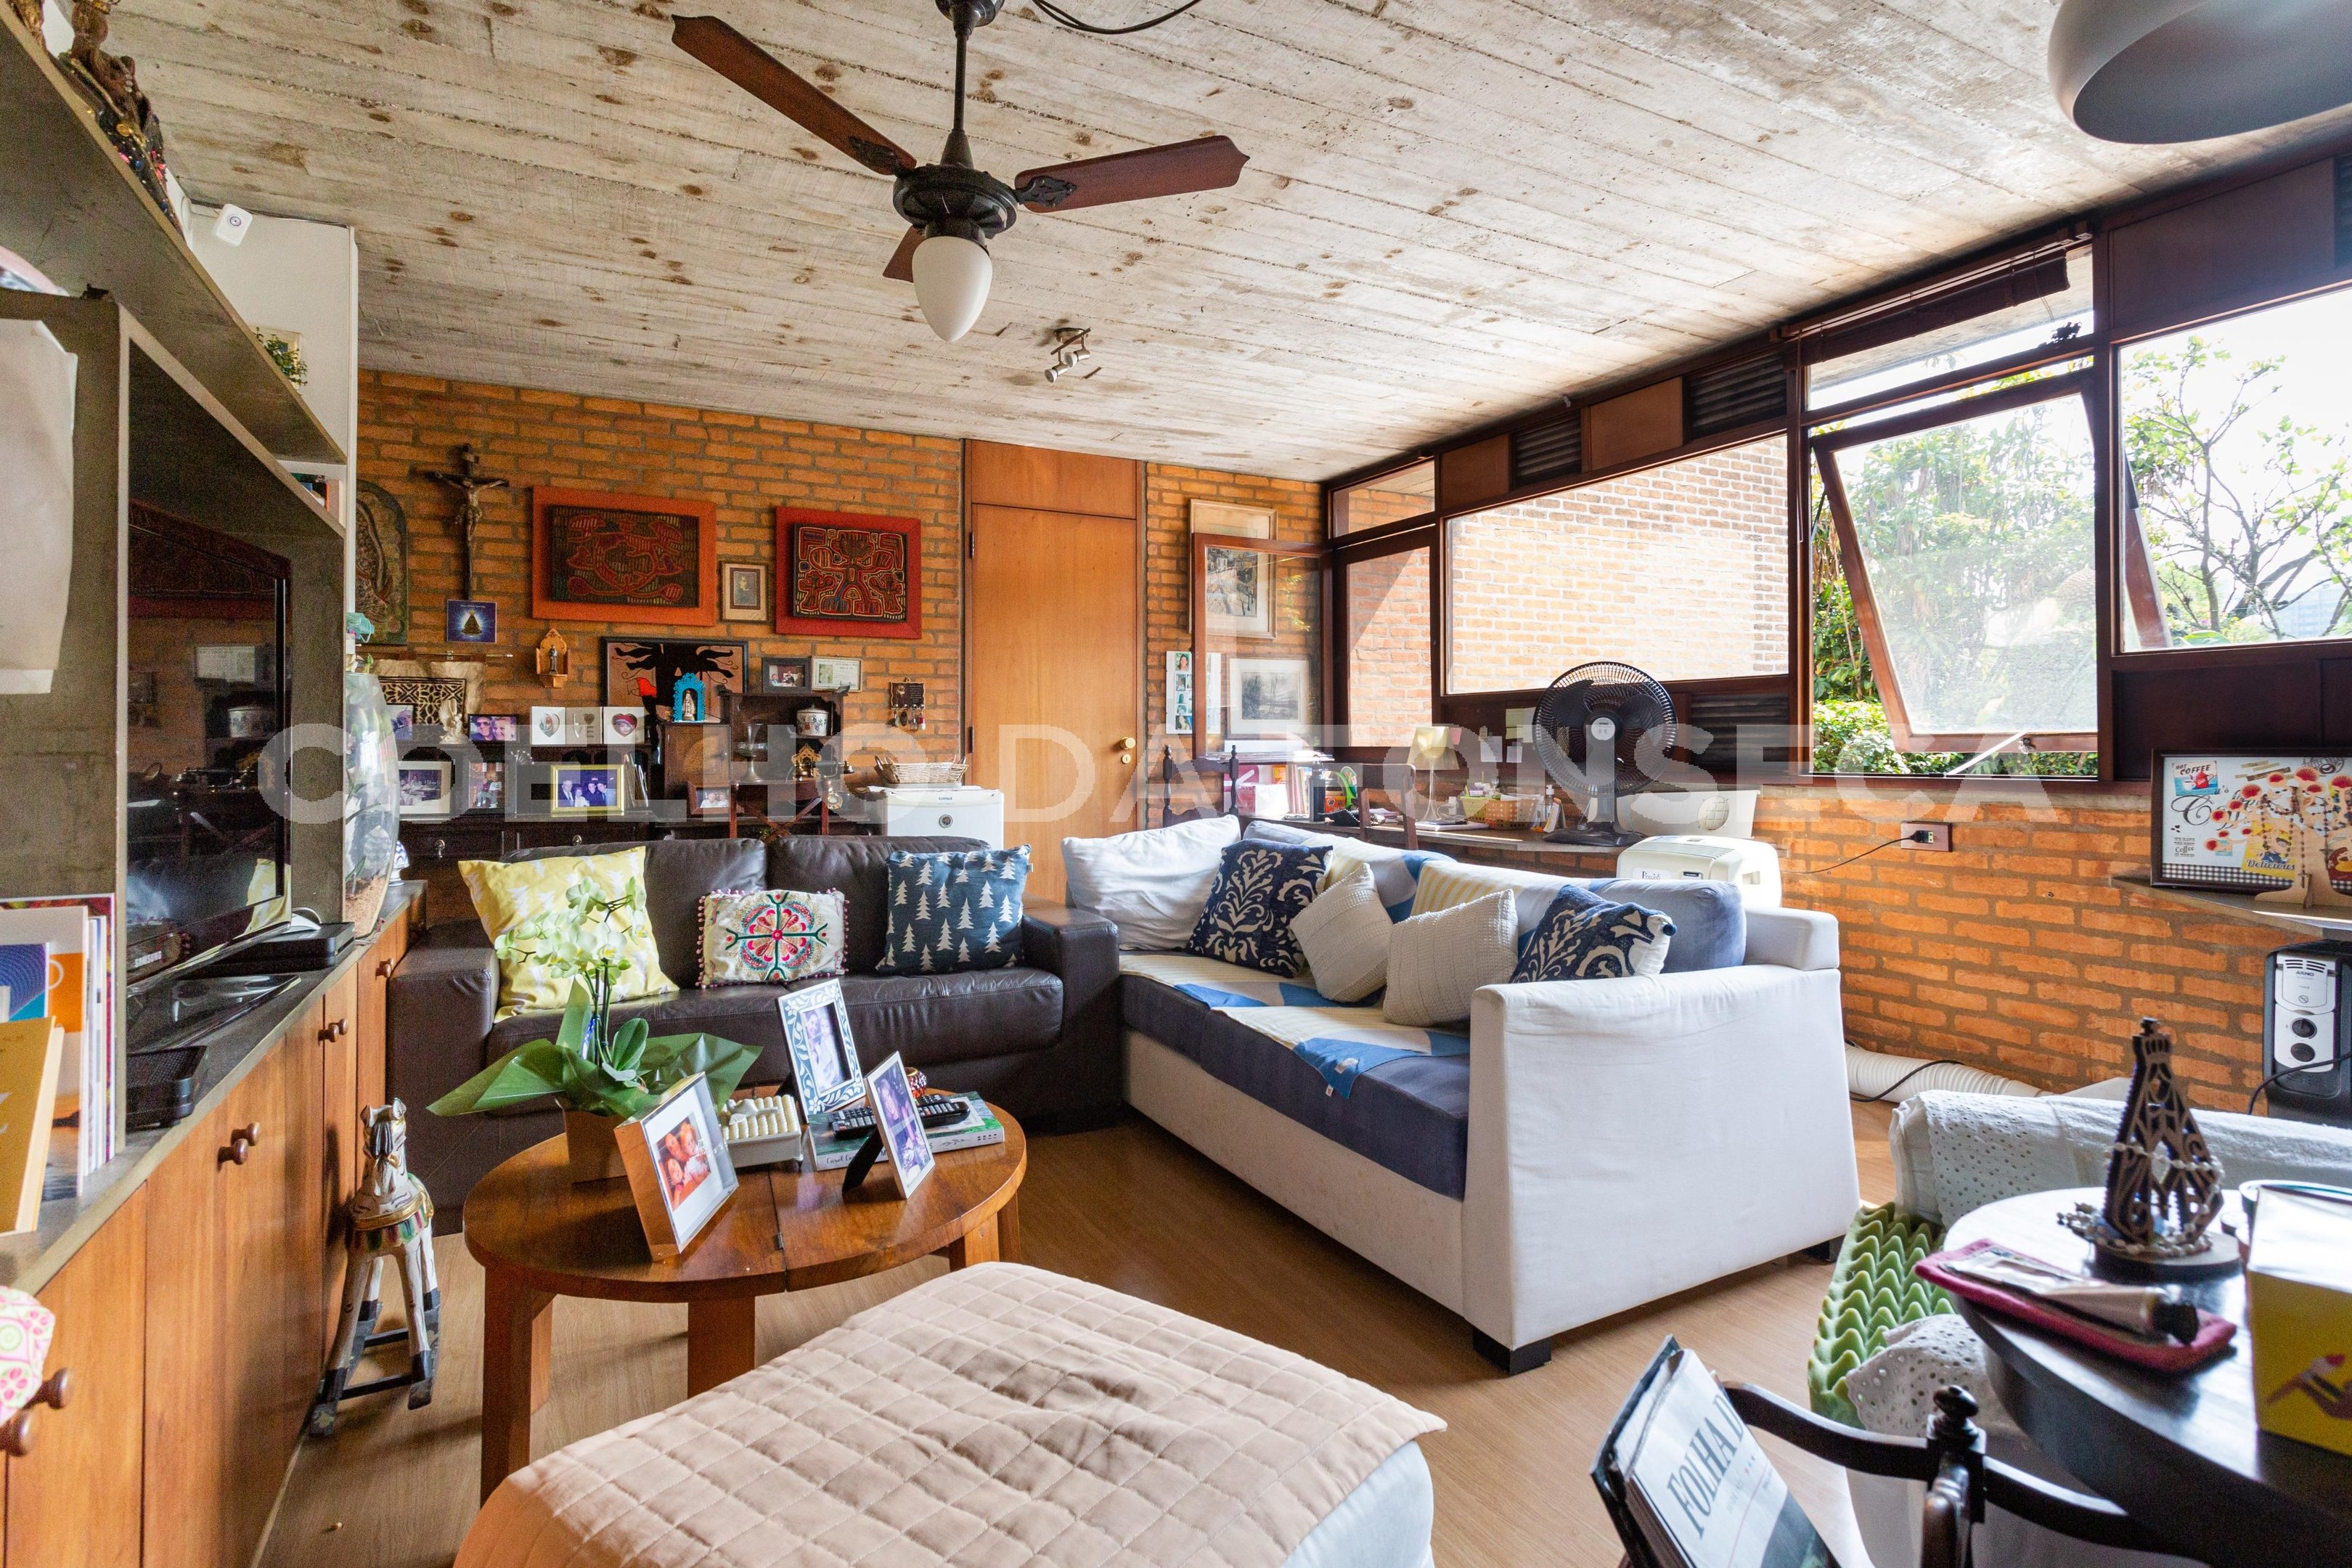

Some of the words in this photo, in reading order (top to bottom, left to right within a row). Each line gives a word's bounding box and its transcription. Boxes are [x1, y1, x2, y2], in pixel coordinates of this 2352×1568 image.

[2180, 764, 2211, 775] COFFEE
[2246, 859, 2295, 870] Delicious
[1667, 1417, 1737, 1540] FOLHA
